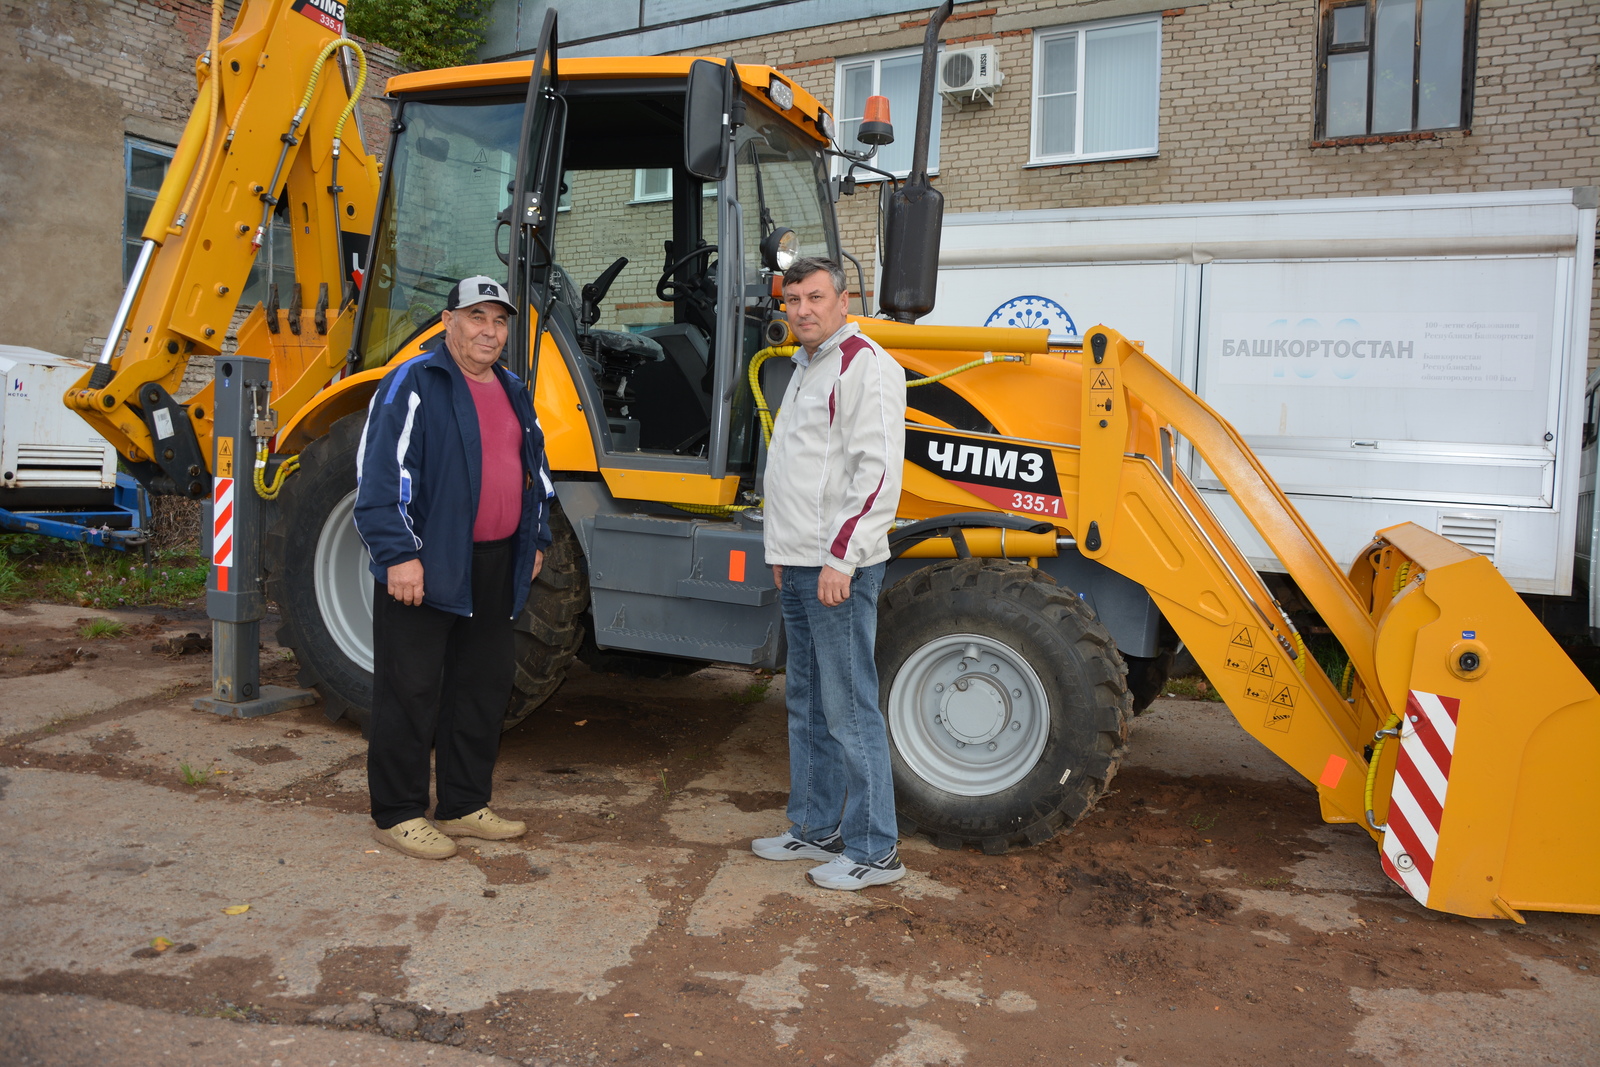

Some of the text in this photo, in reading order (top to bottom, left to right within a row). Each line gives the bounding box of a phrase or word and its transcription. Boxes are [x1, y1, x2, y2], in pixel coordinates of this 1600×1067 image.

[320, 14, 341, 32] 335.1
[1222, 339, 1414, 359] БАШКОРТОСТАН
[928, 440, 1044, 483] ЧЛМЗ
[1011, 492, 1060, 514] 335.1
